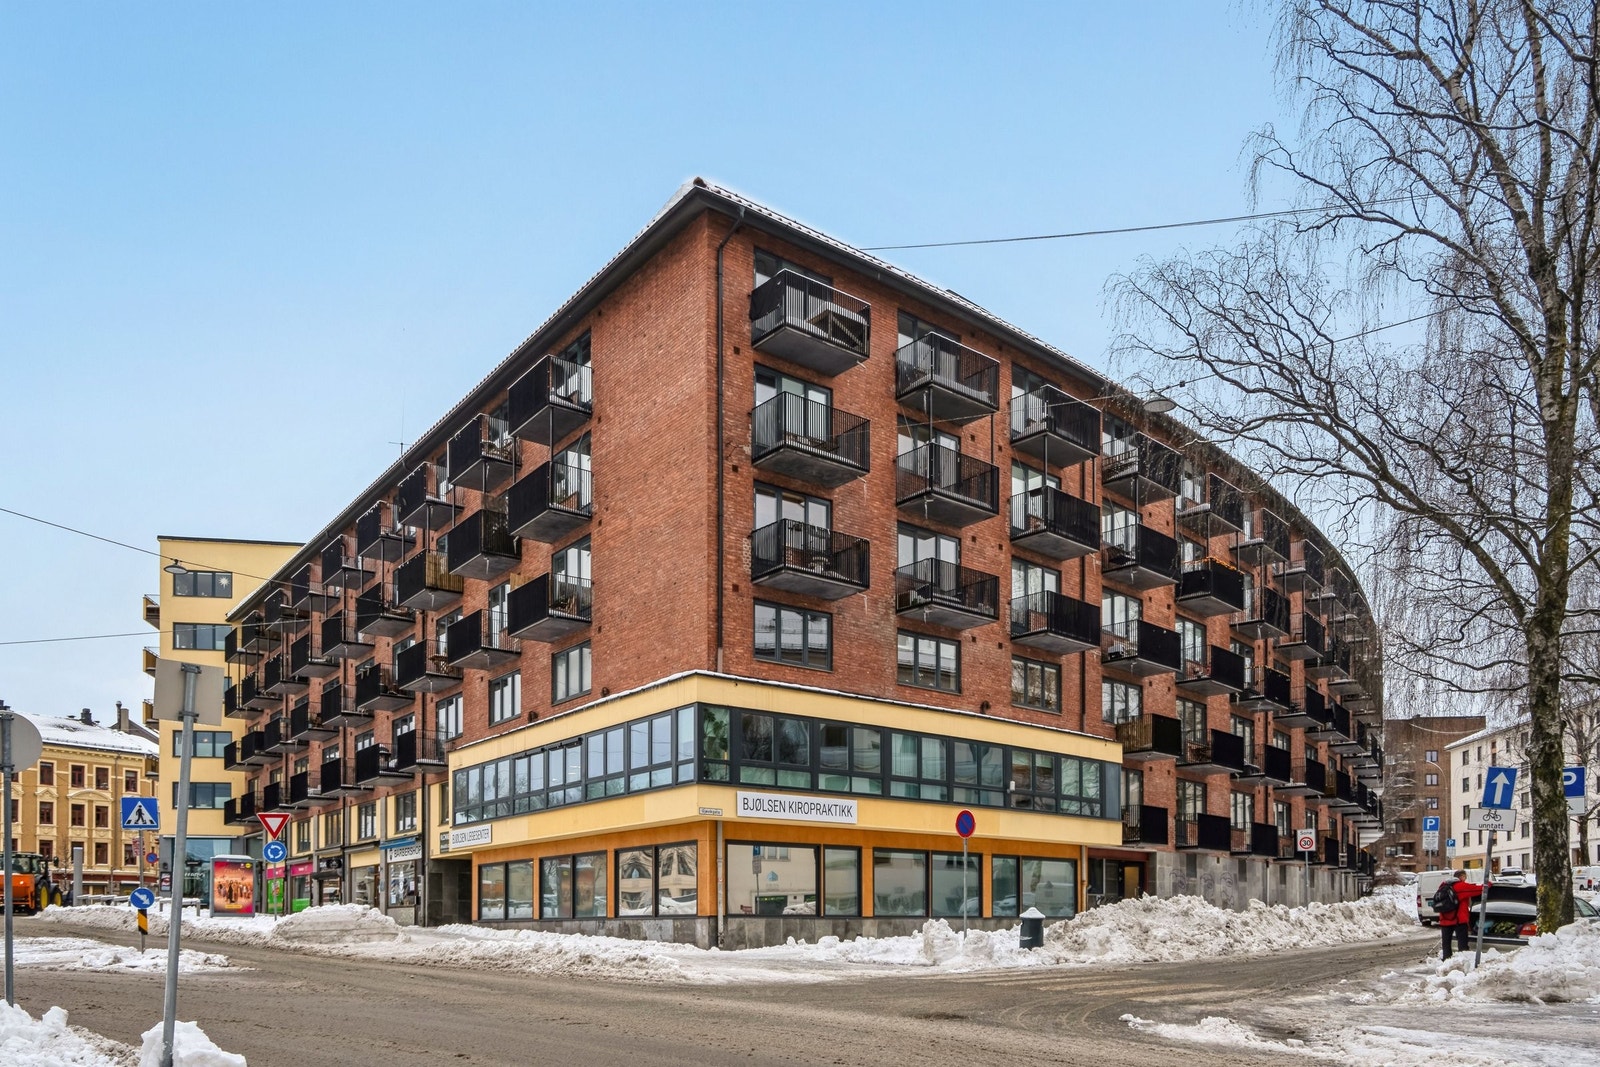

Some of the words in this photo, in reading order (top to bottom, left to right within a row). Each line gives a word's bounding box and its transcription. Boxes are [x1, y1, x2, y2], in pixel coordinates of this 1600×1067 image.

[742, 797, 786, 813] BJØLSEN
[788, 800, 853, 818] KIROPRAKTIKK
[1426, 818, 1436, 830] P
[1302, 839, 1312, 847] 30
[1448, 839, 1454, 847] P
[394, 845, 422, 858] BARBERSHOP
